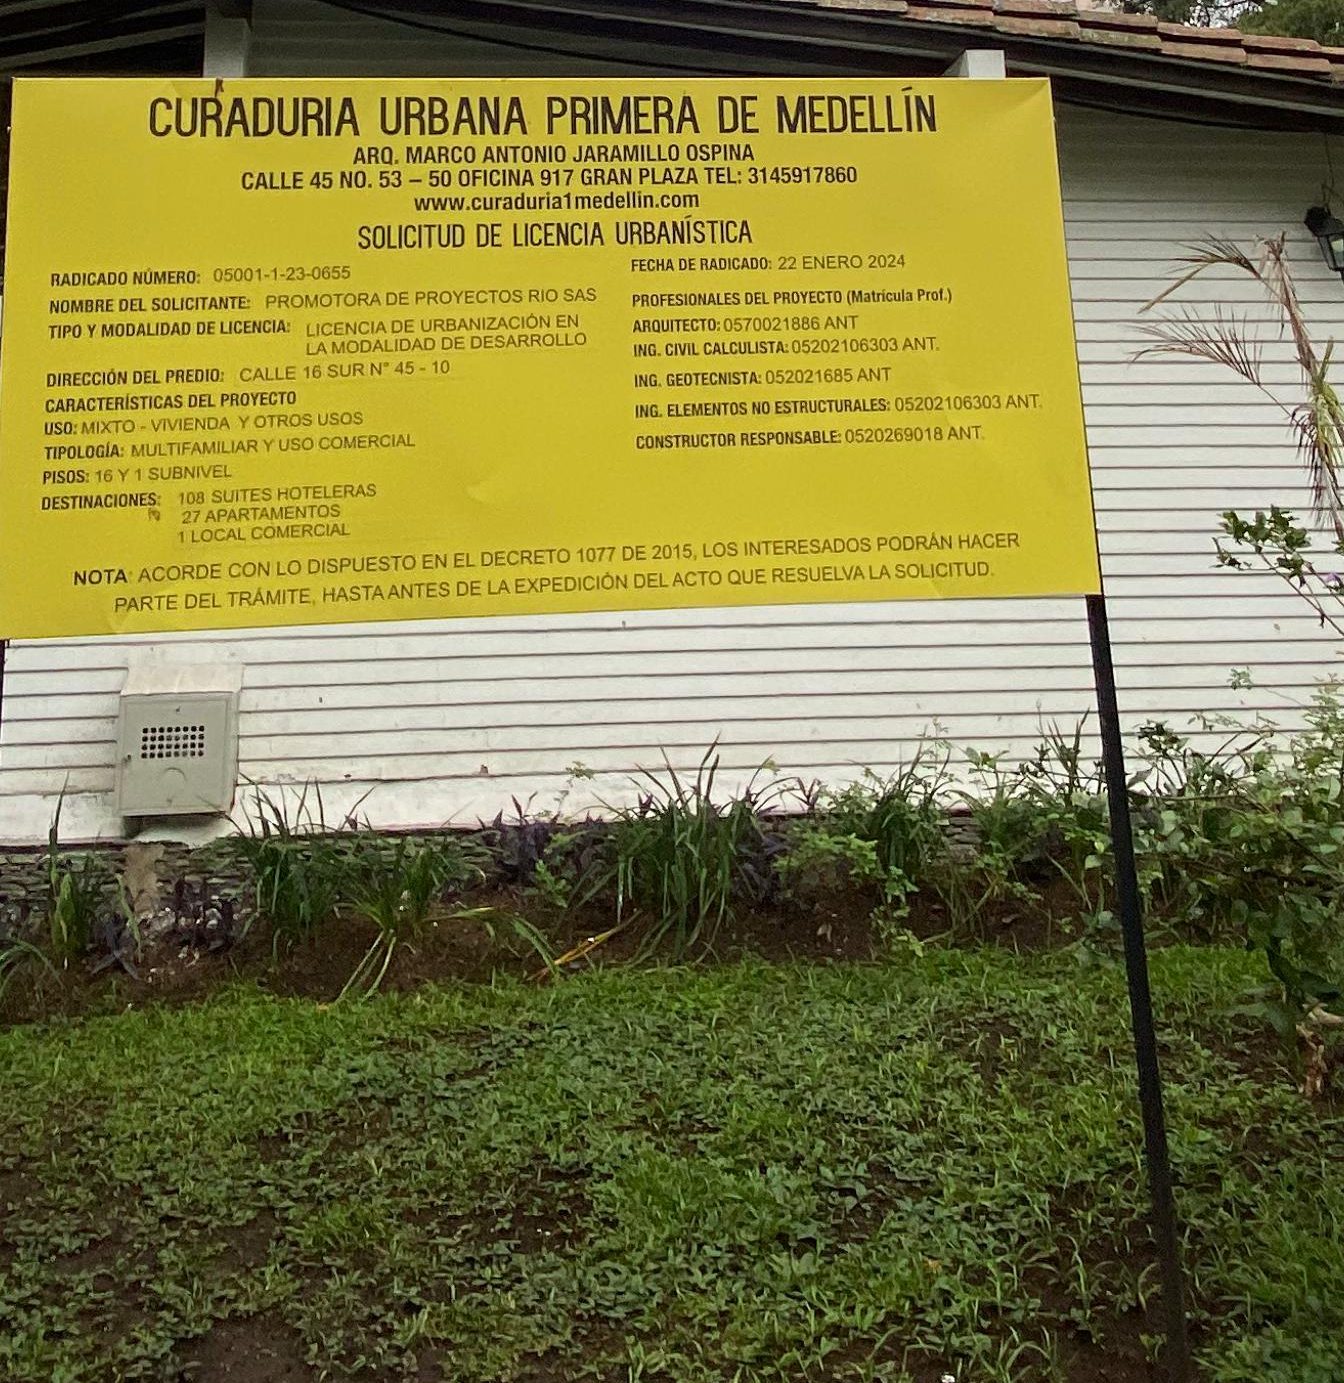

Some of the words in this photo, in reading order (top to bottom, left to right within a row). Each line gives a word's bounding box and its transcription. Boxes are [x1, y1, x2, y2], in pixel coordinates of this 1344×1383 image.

[150, 96, 360, 137] CURADURIA
[381, 97, 528, 135] URBANA
[547, 96, 700, 135] PRIMERA
[718, 96, 759, 133] DE
[776, 87, 936, 133] MEDELLÍN
[353, 147, 398, 165] ARQ.
[406, 146, 476, 164] MARCO
[482, 145, 566, 163] ANTONIO
[573, 144, 679, 162] JARAMILLO
[686, 144, 754, 161] OSPINA
[242, 172, 303, 190] CALLE
[310, 172, 332, 189] 45
[340, 171, 372, 188] NO.
[380, 171, 402, 188] 53
[429, 170, 451, 187] 50
[458, 169, 534, 187] OFICINA
[541, 169, 574, 186] 917
[581, 168, 632, 185] GRAN
[639, 167, 698, 185] PLAZA
[704, 167, 741, 184] TEL:
[748, 167, 857, 184] 3145917860
[414, 191, 699, 211] www.curaduria1medellin.com
[358, 224, 464, 249] SOLICITUD
[476, 223, 502, 247] DE
[514, 222, 604, 247] LICENCIA
[616, 215, 752, 245] URBANÍSTICA
[632, 259, 674, 271] FECHA
[679, 258, 696, 271] DE
[700, 257, 772, 270] RADICADO:
[778, 257, 796, 269] 22
[803, 255, 862, 269] ENERO
[868, 255, 905, 268] 2024
[51, 272, 128, 287] RADICADO
[133, 268, 200, 285] NÚMERO:
[214, 266, 350, 282] 05001-1-23-0655
[50, 299, 114, 314] NOMBRE
[119, 298, 146, 312] DEL
[152, 296, 250, 311] SOLICITANTE:
[266, 293, 381, 308] PROMOTORA
[386, 292, 409, 305] DE
[416, 290, 522, 305] PROYECTOS
[529, 289, 558, 302] RIO
[564, 288, 596, 302] SAS
[633, 293, 740, 307] PROFESIONALES
[745, 292, 769, 305] DEL
[774, 291, 842, 304] PROYECTO
[48, 325, 82, 339] TIPO
[87, 324, 96, 338] Y
[102, 322, 190, 337] MODALIDAD
[197, 321, 215, 335] DE
[220, 320, 290, 334] LICENCIA:
[306, 321, 387, 337] LICENCIA
[392, 319, 414, 333] DE
[421, 313, 550, 332] URBANIZACIÓN
[556, 314, 578, 328] EN
[633, 318, 720, 333] ARQUITECTO:
[724, 317, 820, 332] 0570021886
[824, 315, 858, 329] ANT
[306, 342, 327, 355] LA
[332, 337, 436, 353] MODALIDAD
[442, 337, 465, 350] DE
[471, 333, 586, 349] DESARROLLO
[634, 344, 661, 357] ING.
[665, 343, 699, 356] CIVIL
[704, 341, 789, 355] CALCULISTA:
[792, 338, 898, 353] 05202106303
[47, 369, 127, 387] DIRECCIÓN
[133, 370, 161, 384] DEL
[166, 369, 224, 383] PREDIO:
[240, 366, 296, 381] CALLE
[304, 365, 321, 379] 16
[328, 363, 364, 378] SUR
[395, 361, 414, 375] 45
[433, 360, 449, 373] 10
[635, 374, 662, 387] ING.
[666, 371, 762, 386] GEOTECNISTA:
[766, 369, 852, 384] 052021685
[857, 367, 891, 382] ANT
[46, 393, 183, 413] CARACTERÍSTICAS
[188, 394, 216, 408] DEL
[221, 391, 296, 407] PROYECTO
[636, 405, 662, 418] ING.
[668, 402, 747, 417] ELEMENTOS
[752, 401, 770, 415] NO
[775, 398, 890, 414] ESTRUCTURALES:
[895, 395, 1001, 411] 05202106303
[44, 421, 77, 435] USO:
[81, 419, 135, 434] MIXTO
[151, 417, 230, 432] VIVIENDA
[239, 416, 249, 428] Y
[254, 413, 312, 428] OTROS
[318, 412, 363, 426] USOS
[44, 441, 124, 460] TIPOLOGÍA:
[132, 439, 258, 457] MULTIFAMILIAR
[263, 439, 274, 452] Y
[279, 437, 314, 451] USO
[319, 434, 415, 450] COMERCIAL
[636, 433, 736, 449] CONSTRUCTOR
[741, 430, 841, 446] RESPONSABLE:
[845, 427, 943, 443] 0520269018
[43, 470, 89, 485] PISOS:
[96, 469, 112, 482] 16
[118, 469, 129, 481] Y
[135, 469, 140, 481] 1
[148, 465, 232, 480] SUBNIVEL
[42, 492, 160, 510] DESTINACIONES:
[178, 492, 204, 505] 108
[212, 488, 272, 503] SUITES
[278, 484, 376, 500] HOTELERAS
[182, 510, 200, 524] 27
[205, 504, 340, 523] APARTAMENTOS
[178, 531, 184, 543] 1
[192, 527, 246, 543] LOCAL
[251, 523, 350, 539] COMERCIAL
[138, 563, 221, 583] ACORDE
[229, 561, 270, 578] CON
[277, 560, 301, 576] LO
[308, 555, 416, 574] DISPUESTO
[422, 554, 447, 569] EN
[454, 553, 476, 568] EL
[481, 549, 570, 566] DECRETO
[577, 547, 616, 563] 1077
[622, 545, 646, 561] DE
[652, 544, 696, 560] 2015,
[703, 542, 738, 557] LOS
[744, 537, 871, 556] INTERESADOS
[877, 532, 952, 551] PODRÁN
[958, 533, 1020, 549] HACER
[115, 595, 178, 613] PARTE
[185, 593, 222, 609] DEL
[226, 587, 315, 607] TRÁMITE,
[323, 585, 384, 603] HASTA
[388, 582, 450, 599] ANTES
[457, 581, 481, 597] DE
[488, 579, 510, 595] LA
[515, 572, 628, 593] EXPEDICIÓN
[634, 573, 668, 589] DEL
[672, 571, 722, 587] ACTO
[728, 569, 766, 585] QUE
[772, 566, 865, 583] RESUELVA
[869, 565, 891, 580] LA
